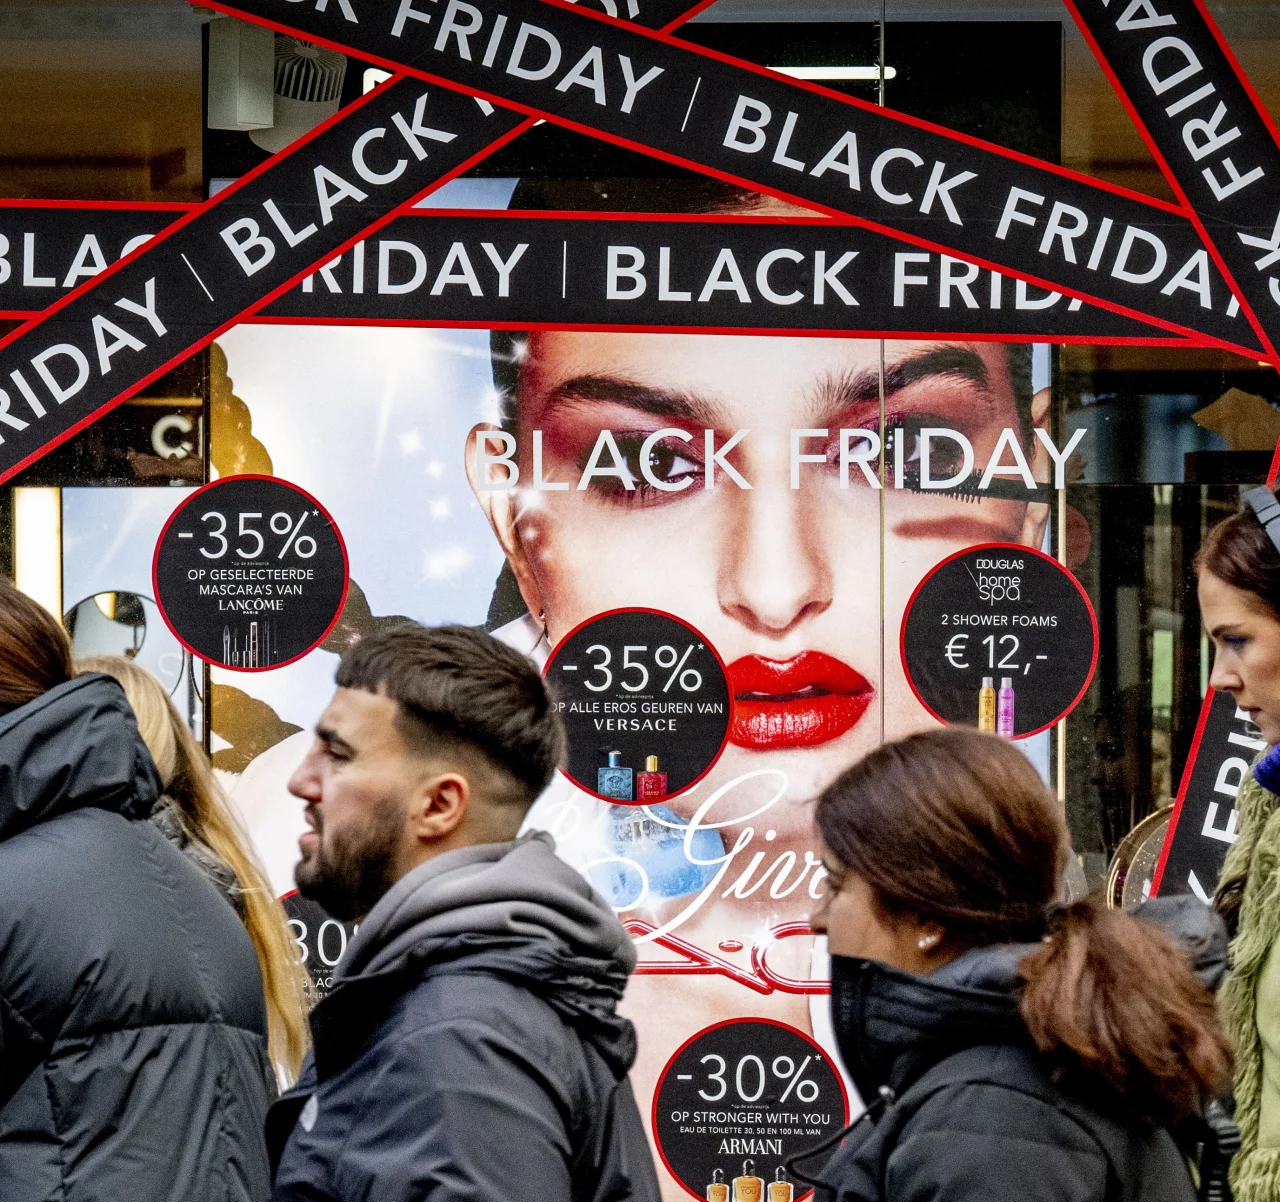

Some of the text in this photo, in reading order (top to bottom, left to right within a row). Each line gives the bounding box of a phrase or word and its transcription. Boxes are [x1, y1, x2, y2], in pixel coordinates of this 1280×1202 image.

[1116, 0, 1265, 202] FRIDA
[392, 0, 1241, 316] FRIDAY BLACK FRIDA
[221, 92, 458, 275] BLACK
[606, 244, 861, 306] BLACK
[475, 428, 1088, 493] BLACK FRIDAY
[976, 559, 1024, 570] DOUGLAS
[188, 570, 314, 580] OP GESELECTEERDE
[979, 572, 1020, 587] home
[199, 584, 302, 595] MASCARA'S VAN
[979, 585, 1020, 606] spa
[218, 598, 283, 611] LANCÔME
[941, 614, 1058, 627] 2 SHOWER FOAMS
[944, 633, 1048, 675] € 12,-
[570, 702, 600, 713] ALLE
[604, 702, 637, 713] EROS
[641, 702, 693, 714] GEUREN
[697, 702, 723, 714] VAN
[593, 718, 677, 731] VERSACE
[671, 1111, 830, 1125] OP STRONGER WITH YOU
[680, 1126, 695, 1134] EAU
[697, 1126, 707, 1134] DE
[757, 1127, 766, 1135] 50
[794, 1128, 804, 1136] ML
[806, 1128, 821, 1136] VAN
[718, 1138, 783, 1155] ARMANI
